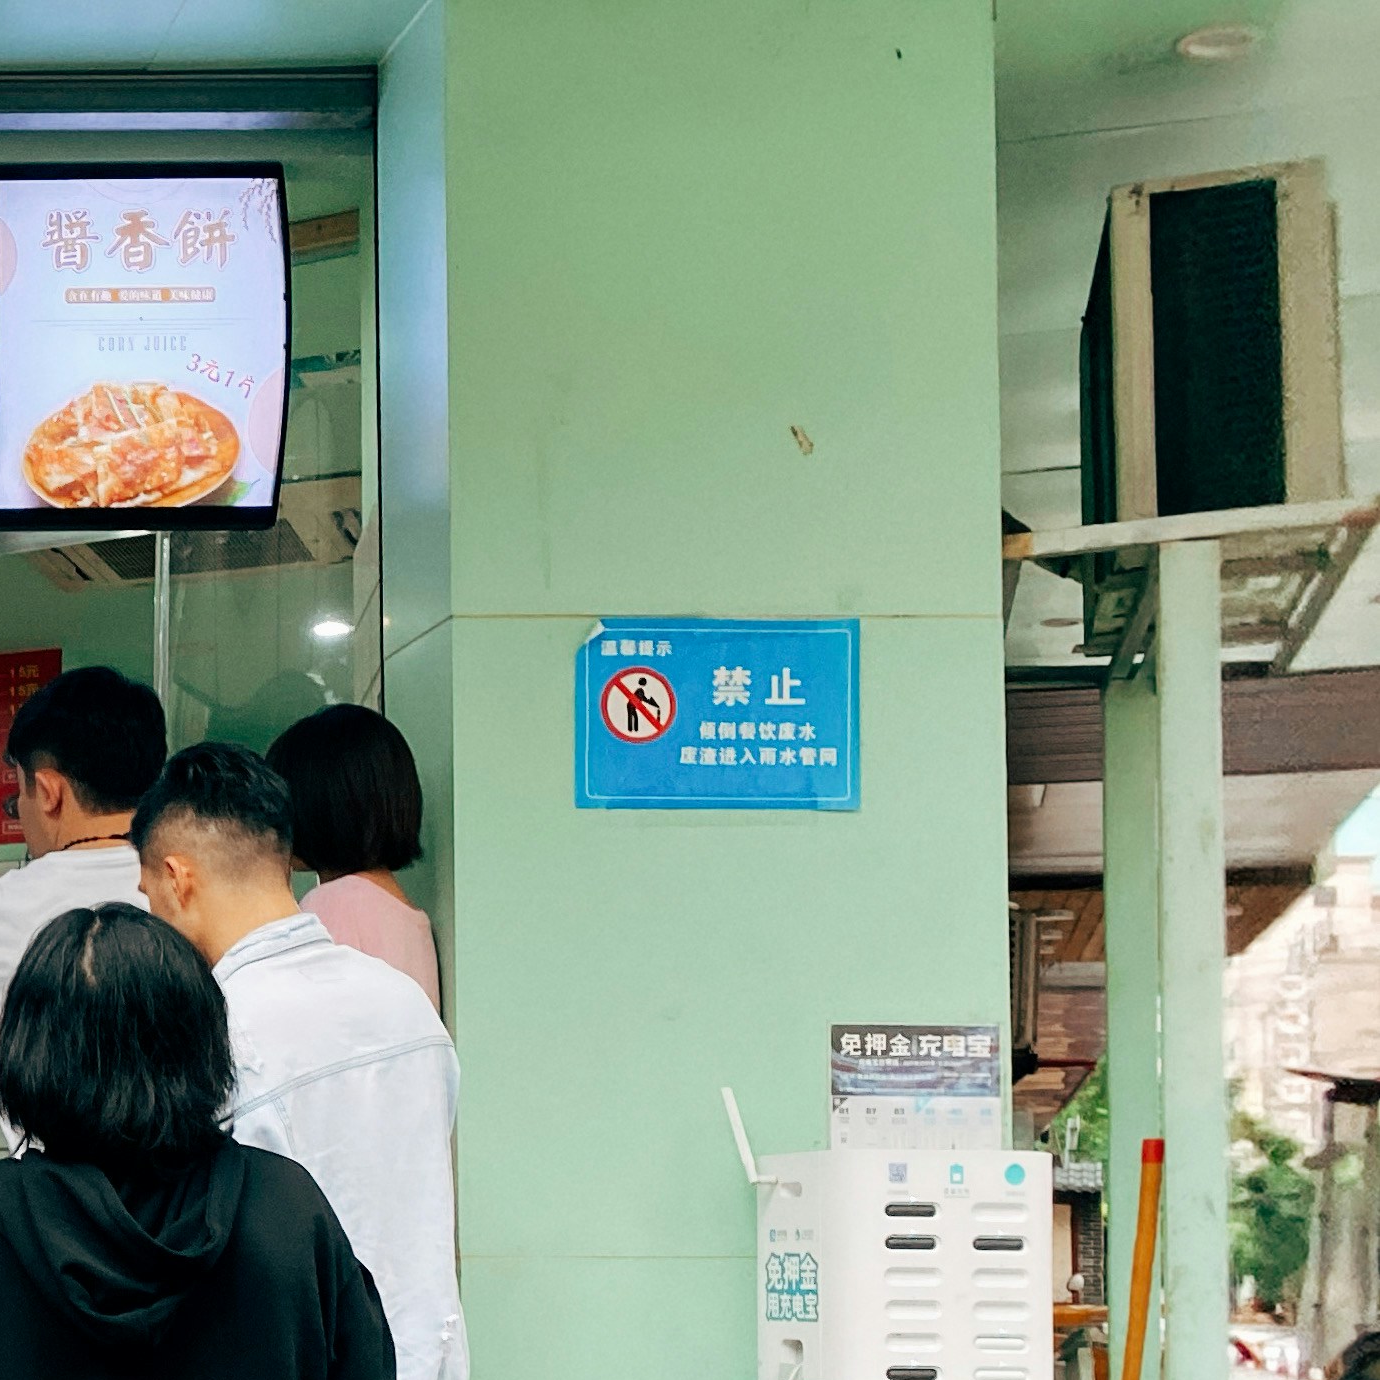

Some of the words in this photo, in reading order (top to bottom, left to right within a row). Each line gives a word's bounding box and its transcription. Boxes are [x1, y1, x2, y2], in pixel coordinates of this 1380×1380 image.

[186, 353, 255, 399] 3元1片
[712, 665, 807, 707] 禁止
[699, 720, 817, 741] 倾倒餐饮废水
[679, 746, 839, 767] 废渣进入雨水管网
[840, 1032, 912, 1058] 免押金
[766, 1253, 818, 1291] 免押金
[766, 1292, 818, 1320] 用充电宝
